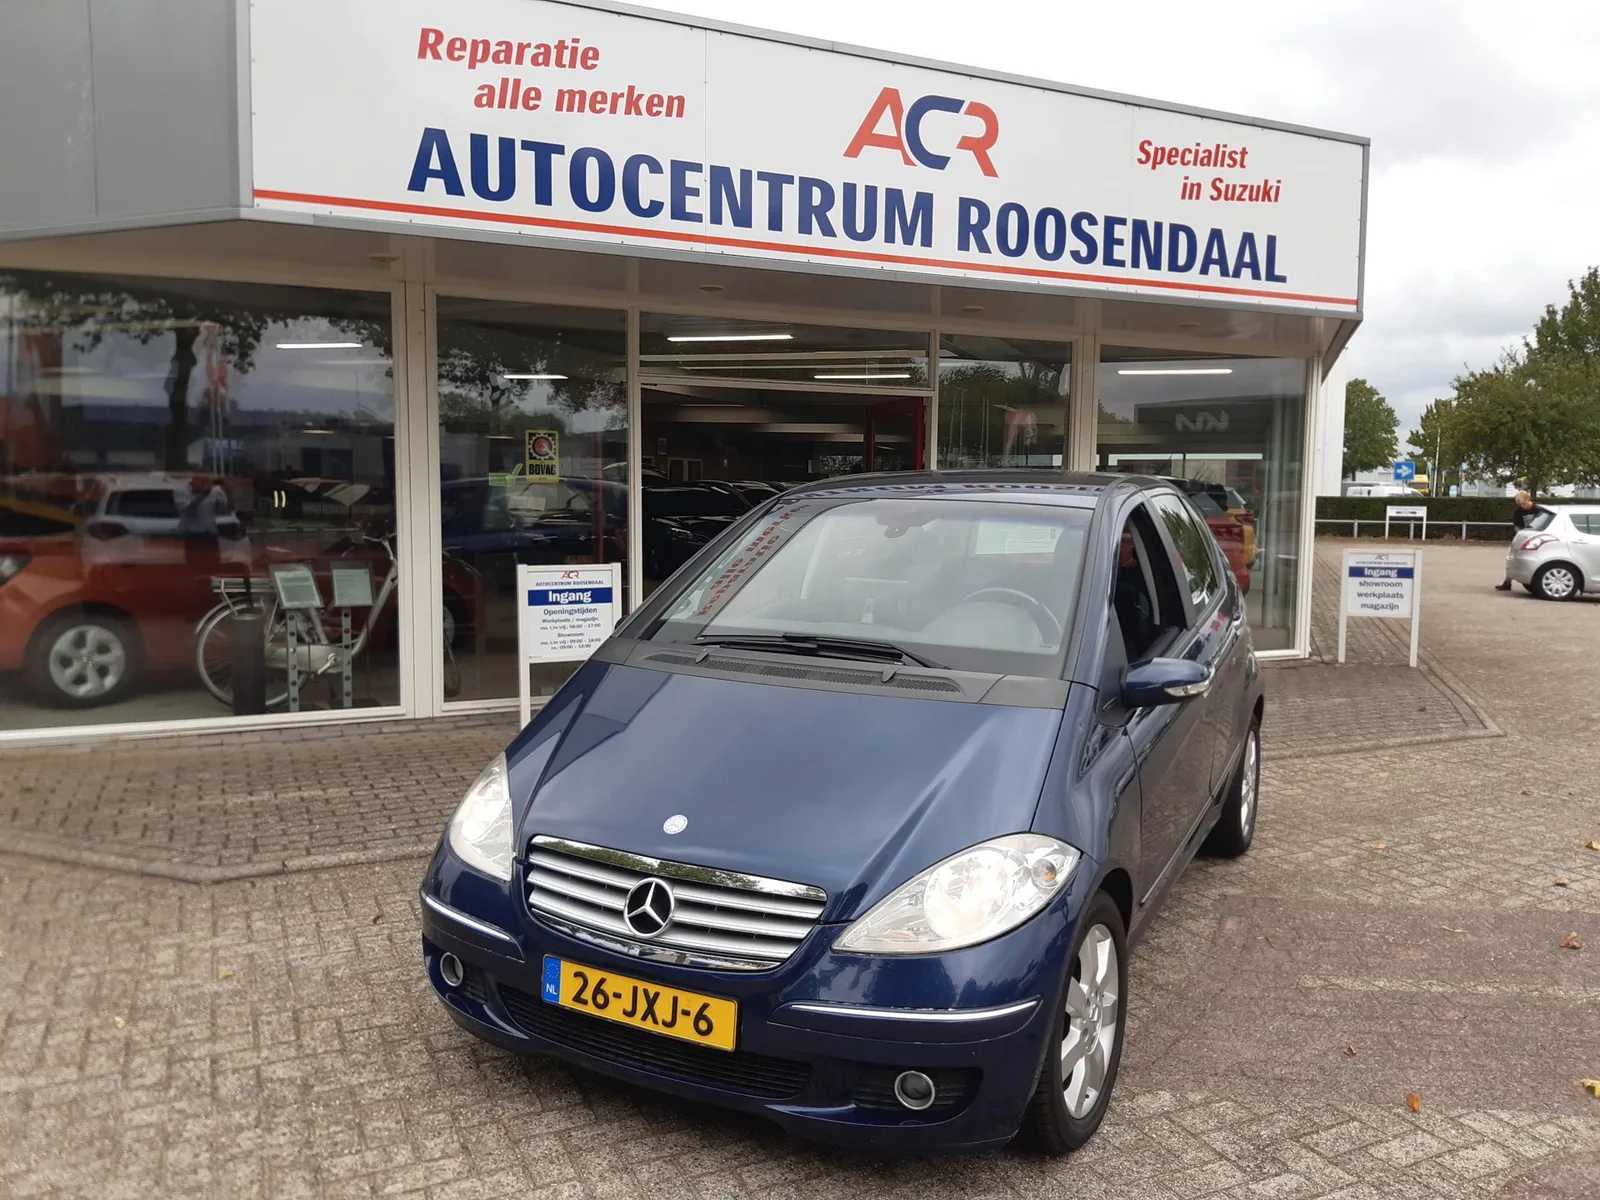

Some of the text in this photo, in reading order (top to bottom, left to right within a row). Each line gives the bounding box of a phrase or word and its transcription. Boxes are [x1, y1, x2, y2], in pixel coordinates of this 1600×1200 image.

[417, 27, 600, 71] Reparatie
[474, 77, 686, 118] alle merken
[844, 87, 999, 178] ACR
[1137, 139, 1249, 170] Specialist
[1181, 176, 1281, 203] in Suzuki
[408, 128, 1286, 282] AUTOCENTRUM ROOSENDAAL
[529, 464, 556, 475] BOVAG
[561, 571, 580, 579] ACR
[1364, 567, 1398, 578] Ingang
[1358, 580, 1403, 588] showroom
[548, 590, 592, 604] Ingang
[1356, 591, 1404, 600] werkplaats
[543, 607, 598, 616] Openingstijden
[1360, 602, 1399, 611] magazijn
[545, 983, 558, 995] NL
[571, 970, 714, 1037] 26-JXJ-6
